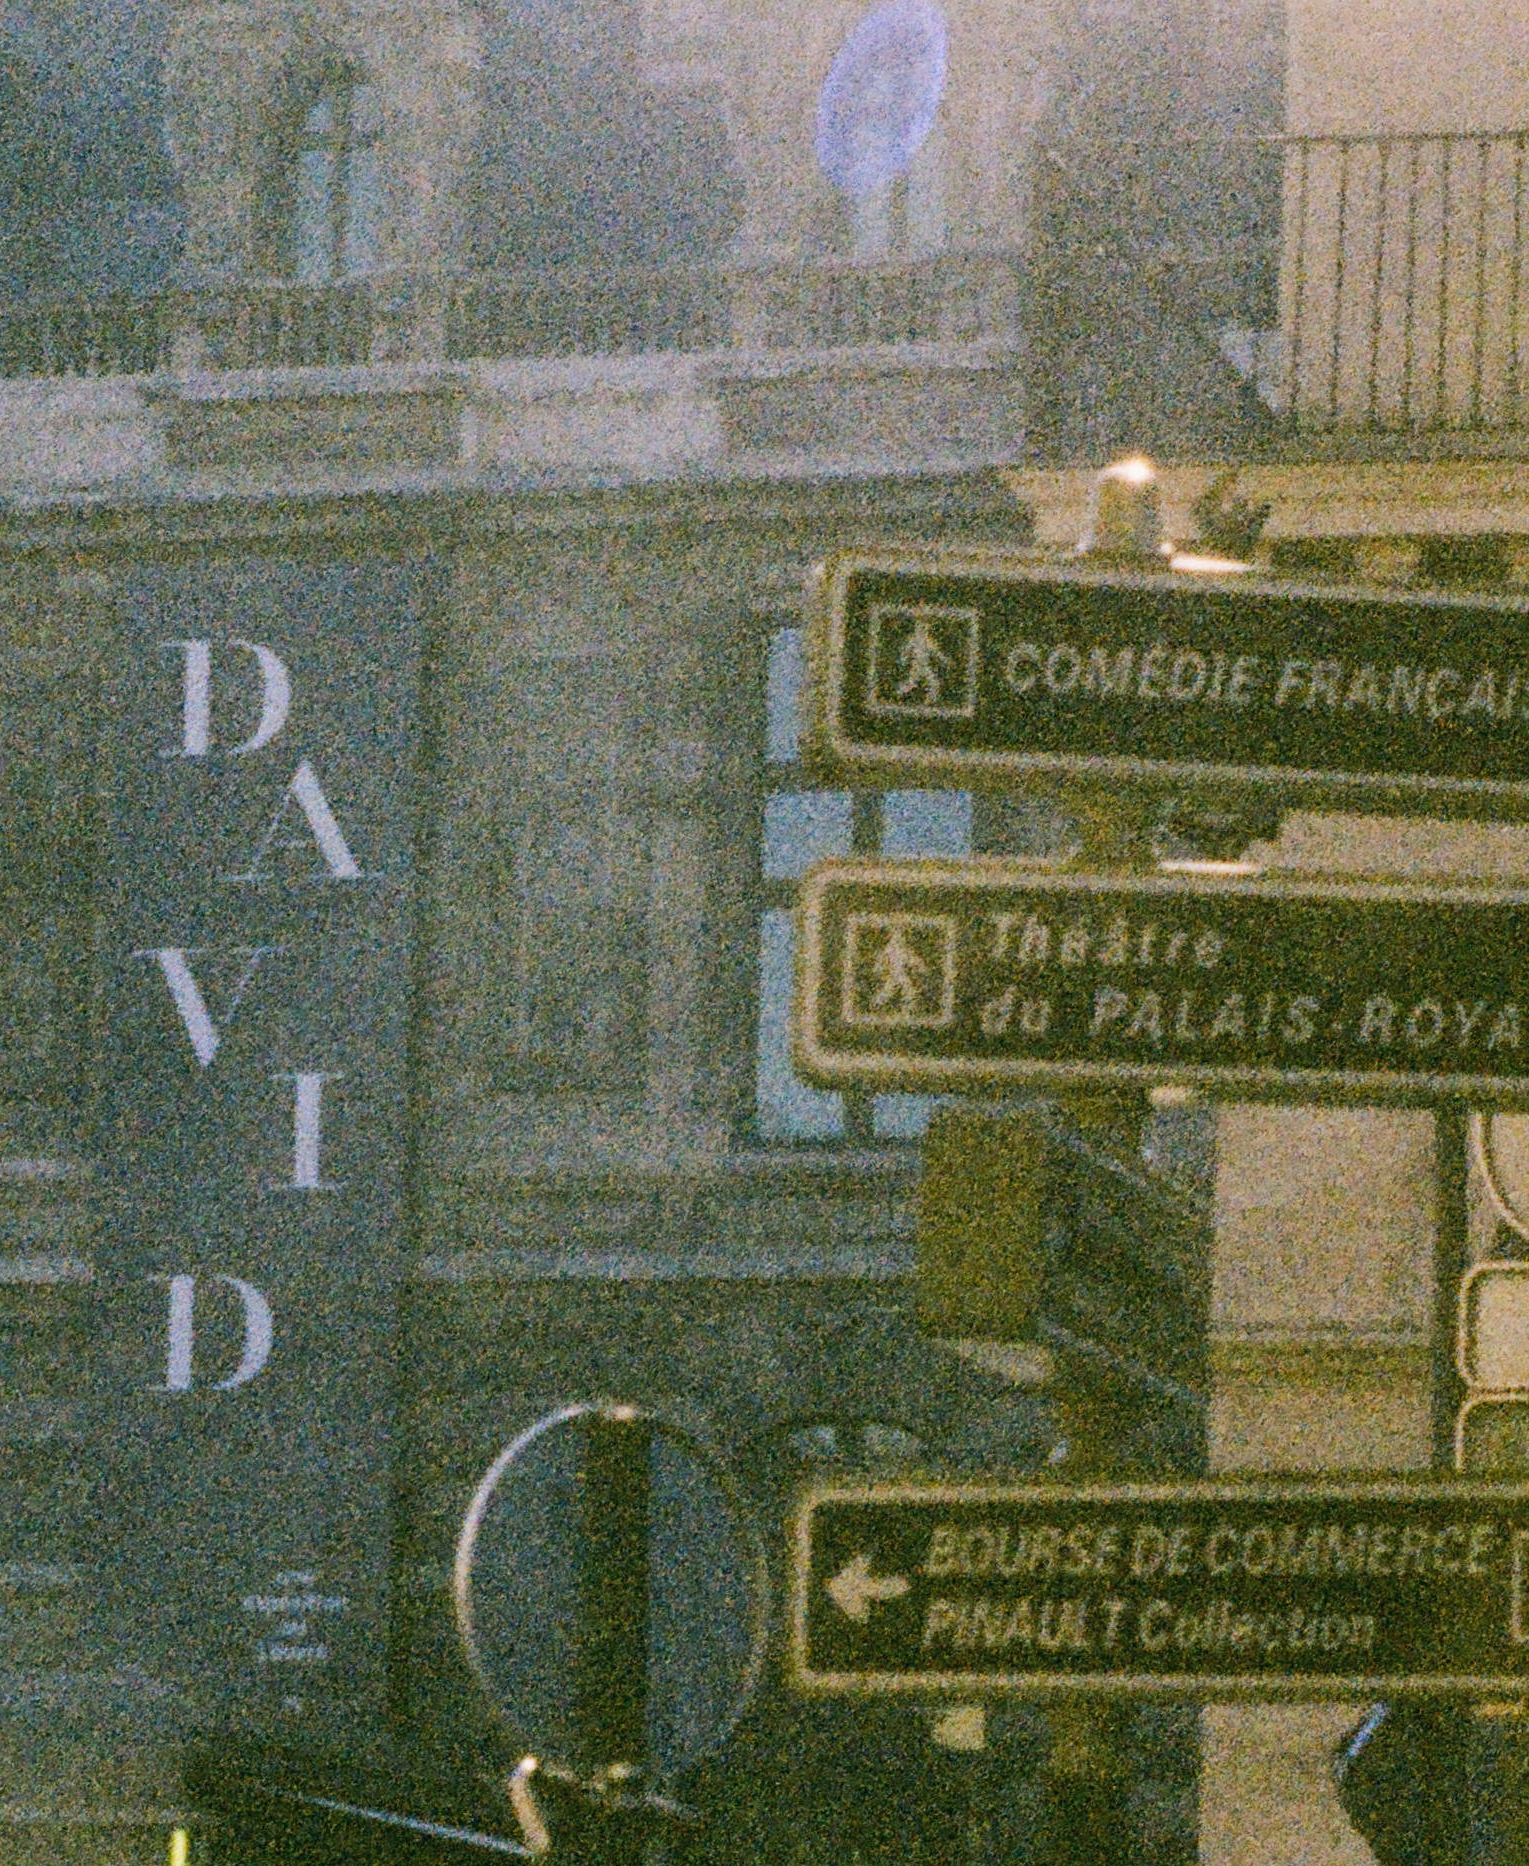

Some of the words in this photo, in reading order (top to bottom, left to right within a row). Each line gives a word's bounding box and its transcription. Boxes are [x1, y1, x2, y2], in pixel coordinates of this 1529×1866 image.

[1002, 639, 1258, 707] COMÉDIE
[133, 638, 385, 1392] DAVID
[979, 988, 1052, 1037] du
[923, 1522, 1118, 1577] BOURSE
[1130, 1523, 1194, 1577] DE
[1204, 1522, 1496, 1578] COMMERCE
[922, 1600, 1124, 1650] PINAULT
[1138, 1600, 1378, 1652] Collection
